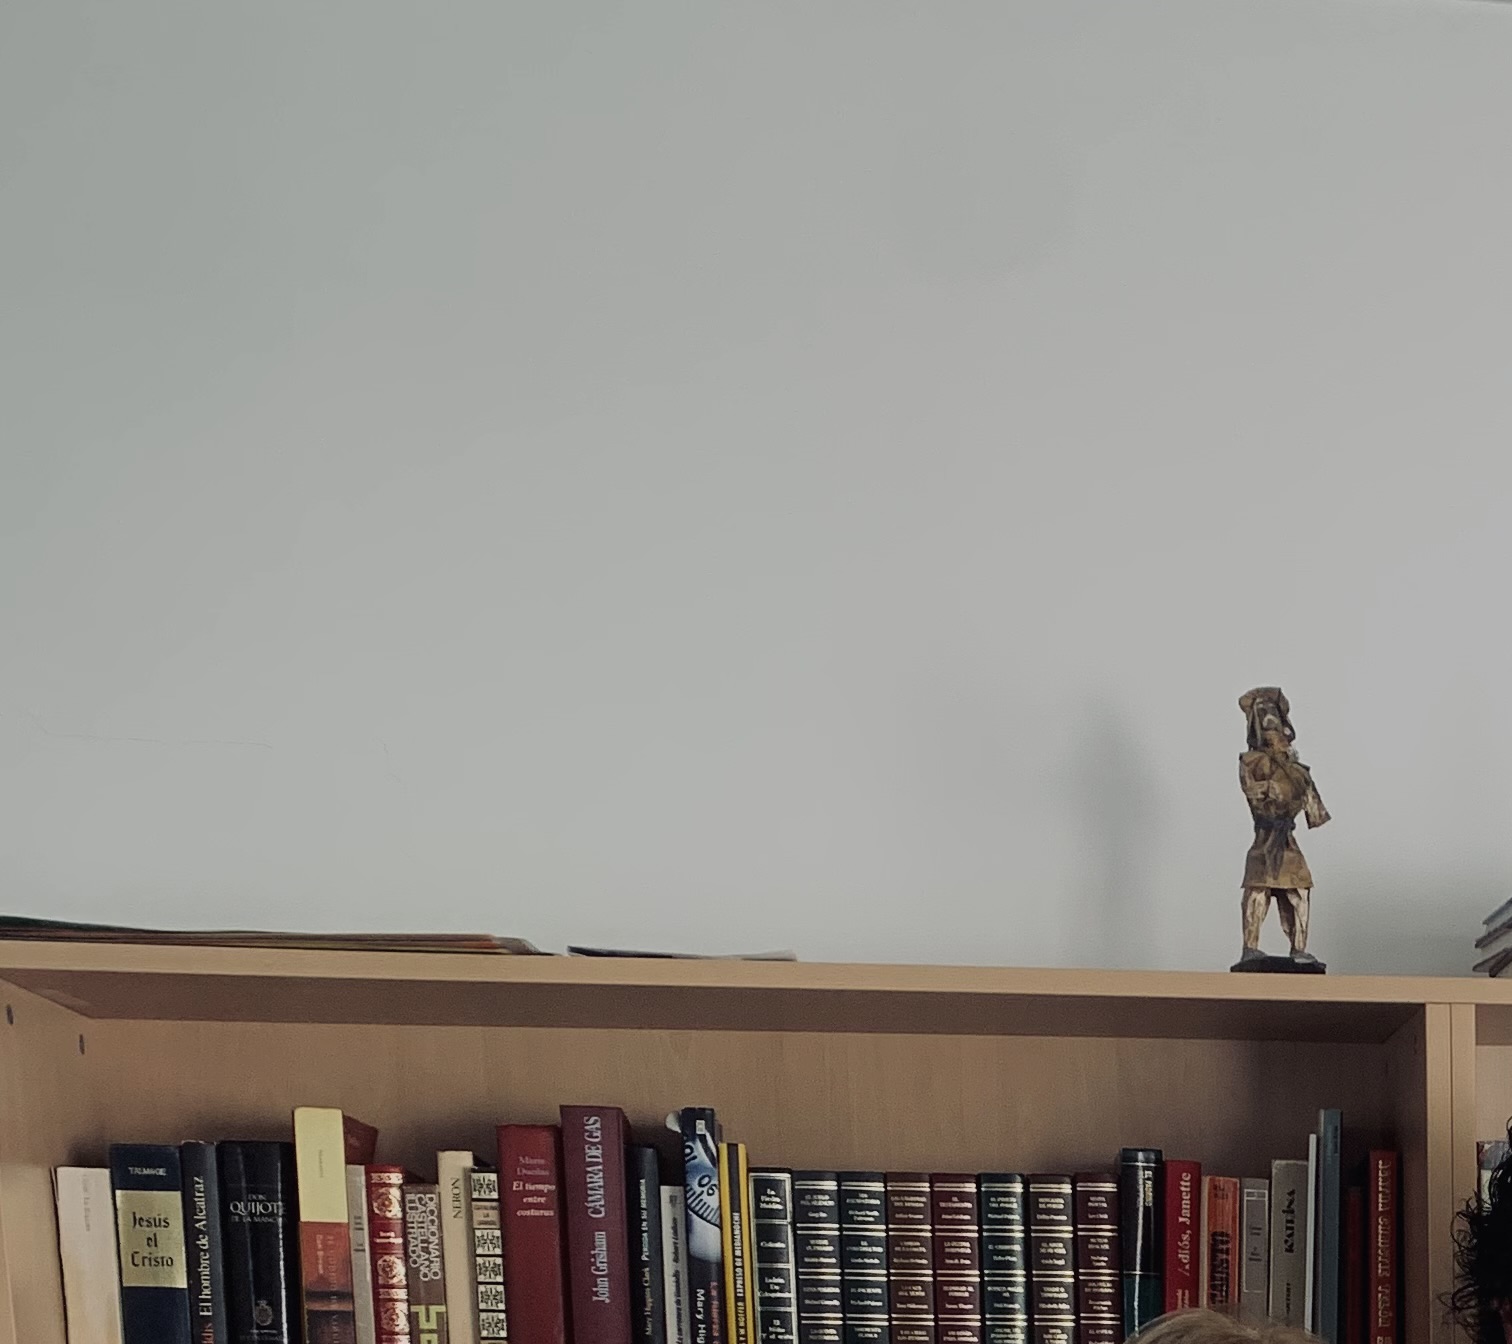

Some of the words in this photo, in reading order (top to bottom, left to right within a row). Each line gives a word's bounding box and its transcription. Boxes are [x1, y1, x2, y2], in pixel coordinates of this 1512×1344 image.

[583, 1116, 603, 1142] GAS
[586, 1144, 604, 1162] DE
[512, 1181, 524, 1191] El
[584, 1165, 606, 1218] CÁMARA
[1178, 1172, 1191, 1225] Janette
[193, 1176, 207, 1229] Alcatraz
[132, 1212, 170, 1229] Jesús
[405, 1193, 419, 1268] ILUSTRADO
[146, 1233, 159, 1248] el
[197, 1234, 209, 1248] de
[415, 1193, 431, 1282] CASTELLANO
[426, 1193, 441, 1281] DICCIONARIO
[131, 1251, 174, 1268] Cristo
[590, 1231, 608, 1275] Grisham
[198, 1248, 212, 1300] hombre
[592, 1277, 610, 1304] John
[695, 1288, 705, 1320] Mary
[200, 1303, 213, 1316] El
